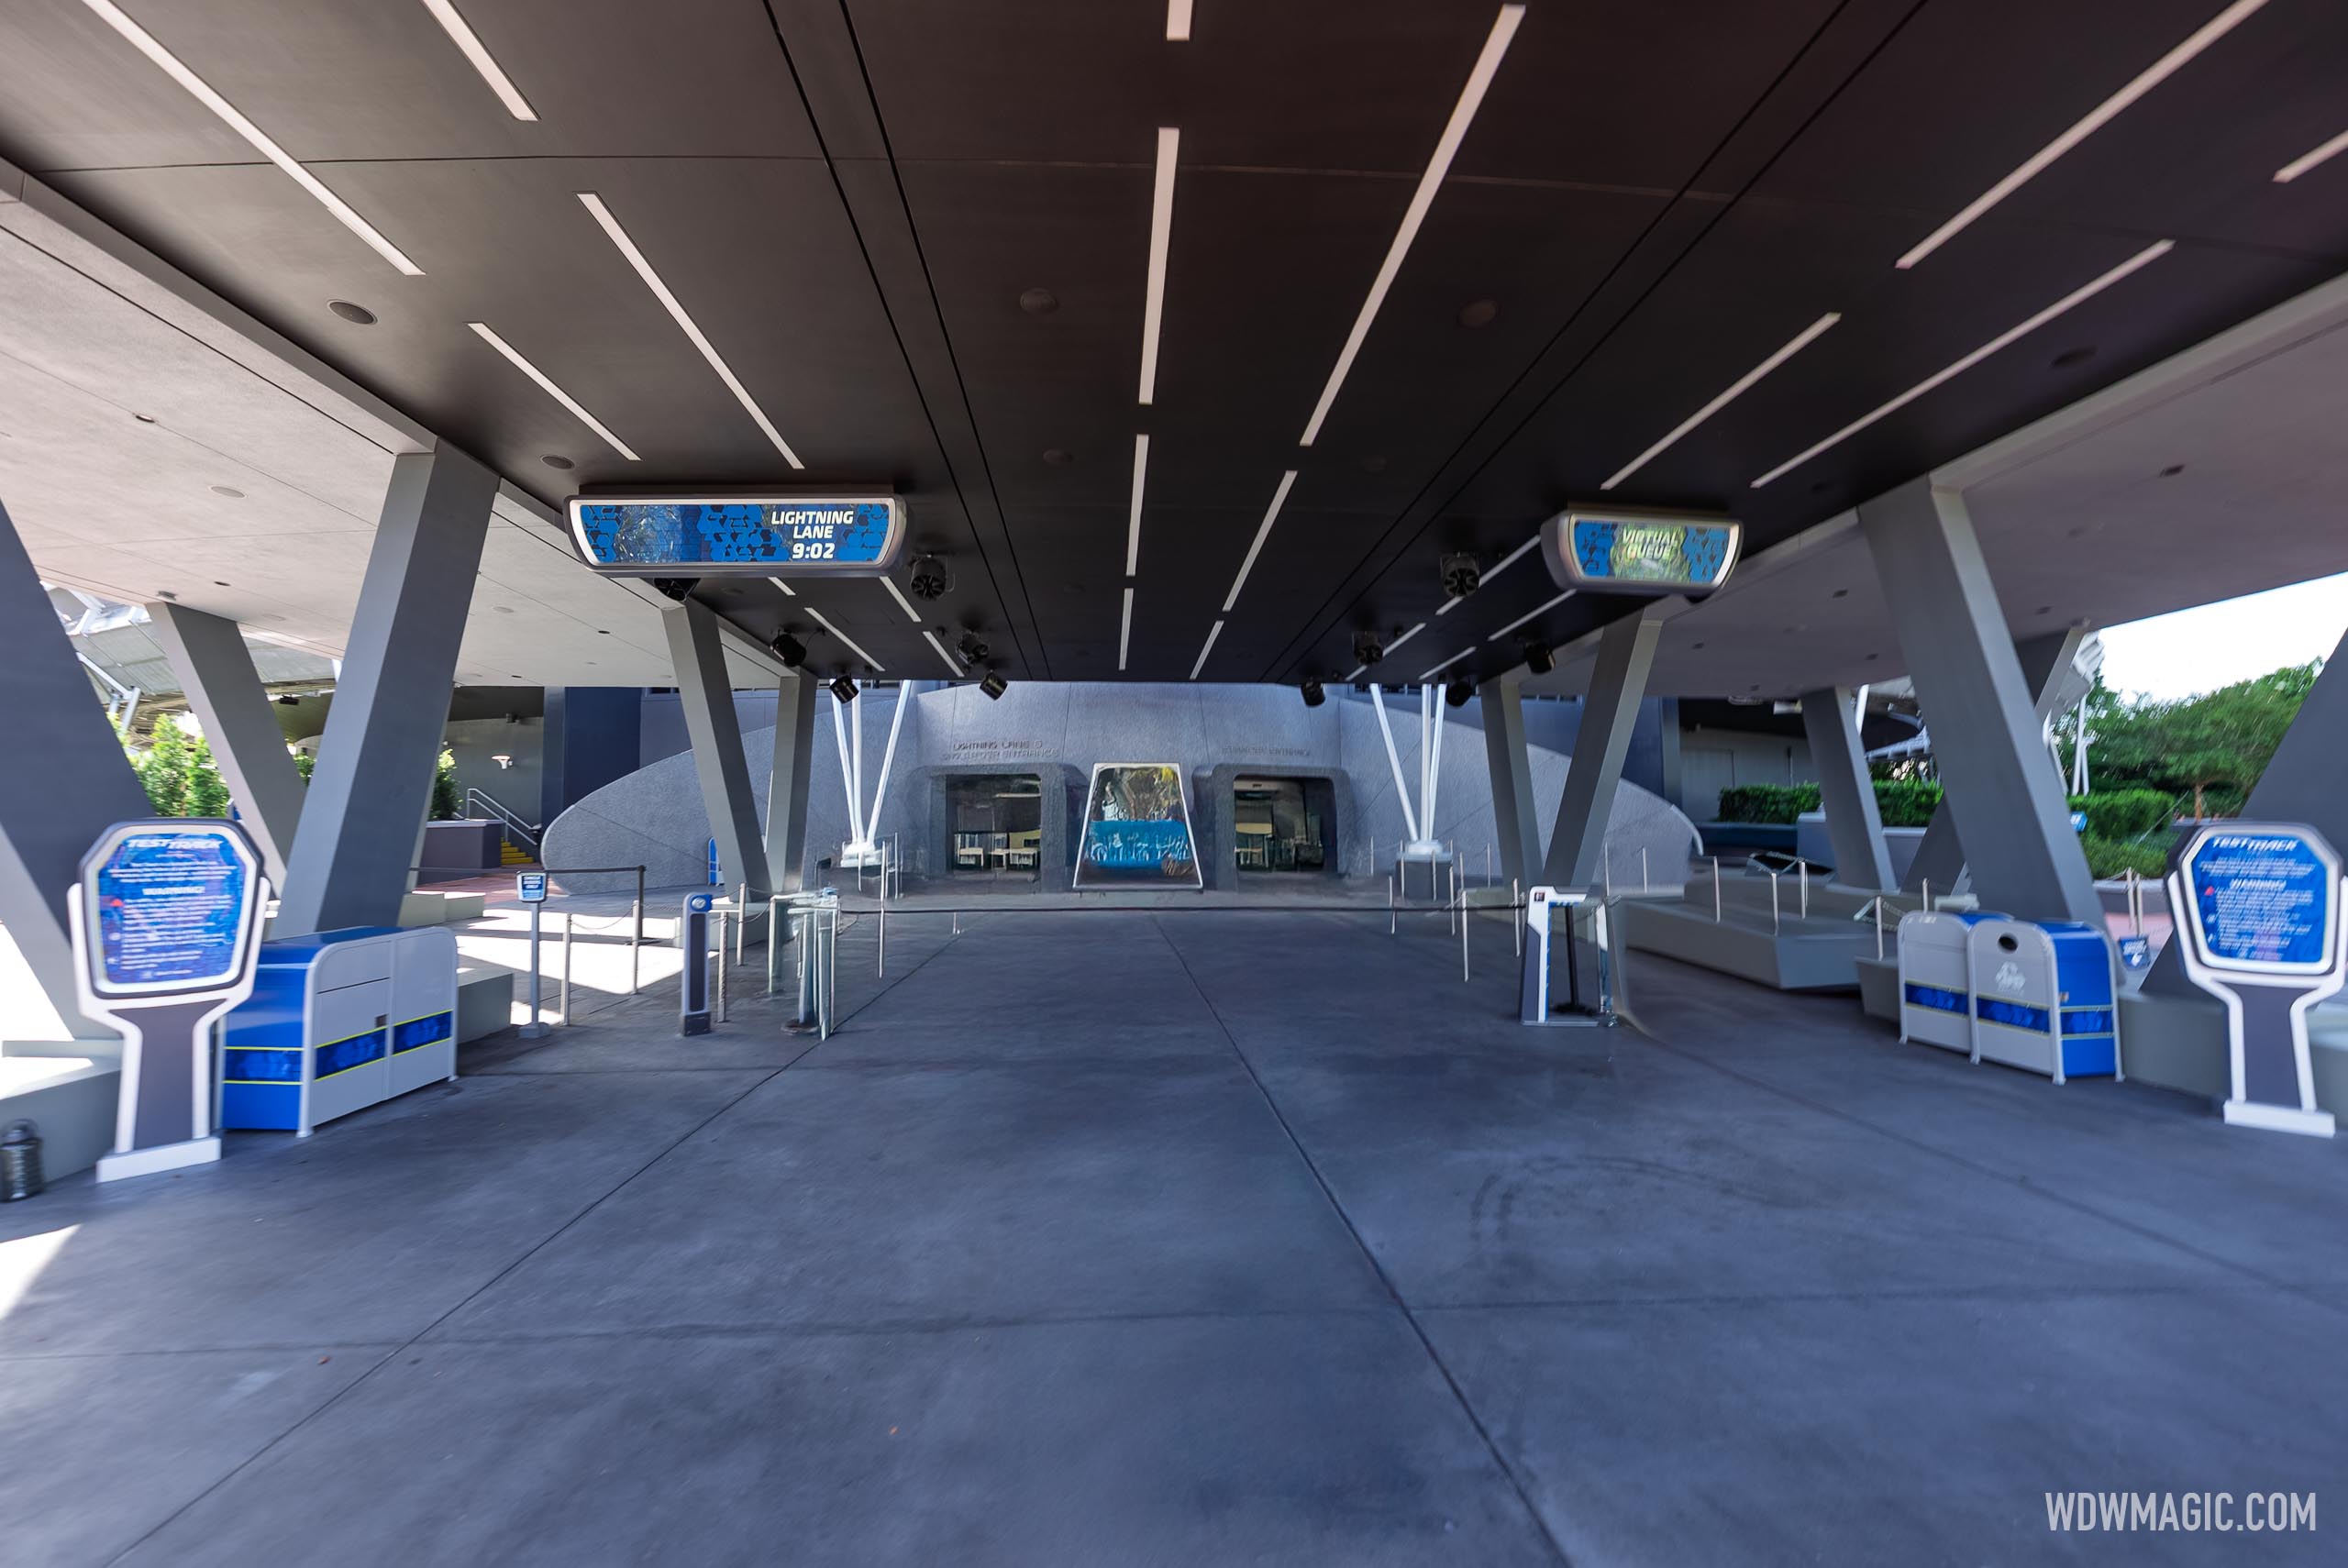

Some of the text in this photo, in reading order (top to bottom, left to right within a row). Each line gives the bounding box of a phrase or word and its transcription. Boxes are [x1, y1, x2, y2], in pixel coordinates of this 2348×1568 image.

[771, 511, 854, 525] LIGHTNING
[792, 525, 834, 539] LANE
[1622, 528, 1678, 547] VIRTUAL
[792, 543, 836, 559] 9:02
[1626, 543, 1672, 559] QUEUE
[127, 839, 224, 849] TEST TRACK
